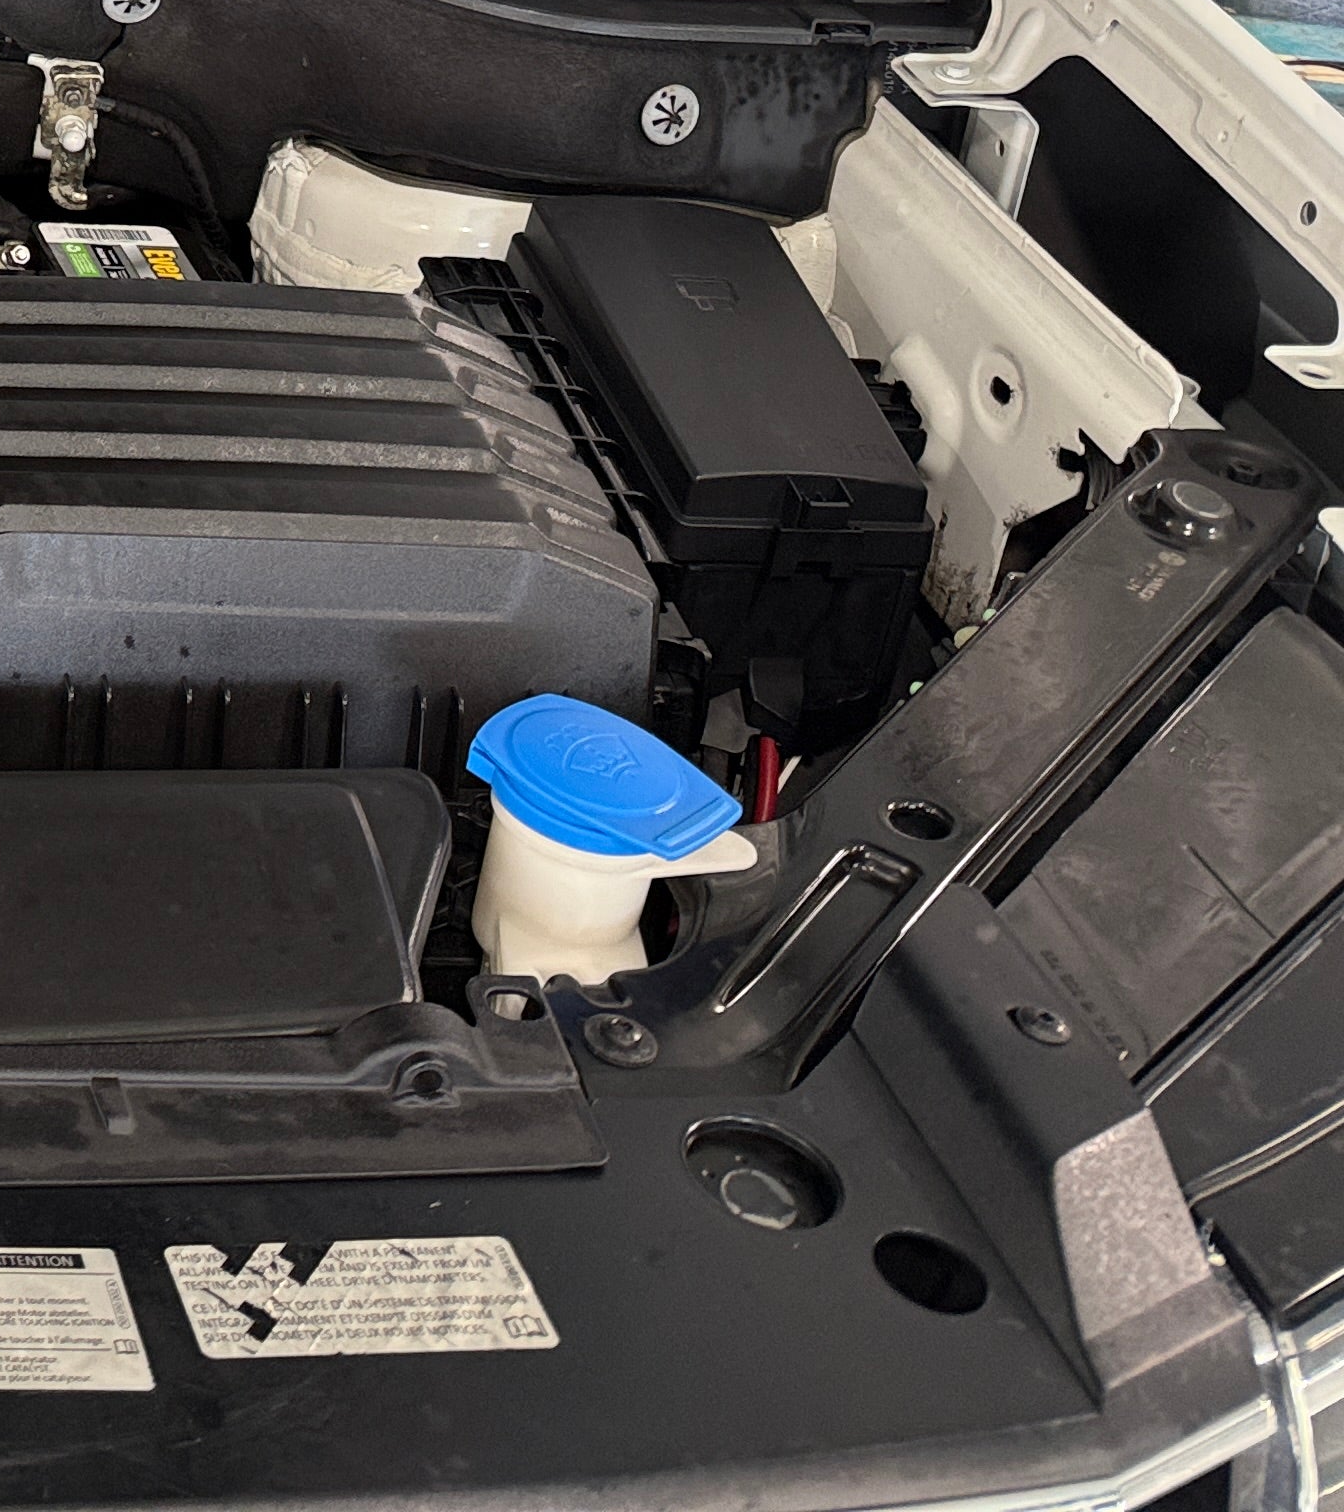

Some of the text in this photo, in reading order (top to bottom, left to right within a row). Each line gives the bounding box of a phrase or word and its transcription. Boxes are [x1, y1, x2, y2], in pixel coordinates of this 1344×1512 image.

[171, 1252, 202, 1264] THIS
[337, 1248, 382, 1259] WITH A
[339, 1262, 367, 1273] AND
[382, 1260, 431, 1272] EXEMPT
[432, 1259, 468, 1270] FROM
[183, 1279, 259, 1291] TESTING ON
[341, 1276, 381, 1287] DRIVE
[25, 1297, 46, 1305] tout
[191, 1303, 211, 1315] CE
[19, 1318, 70, 1327] TOUCHING
[71, 1318, 115, 1327] IGNITION
[202, 1332, 230, 1344] SUR
[344, 1326, 380, 1338] DEUX
